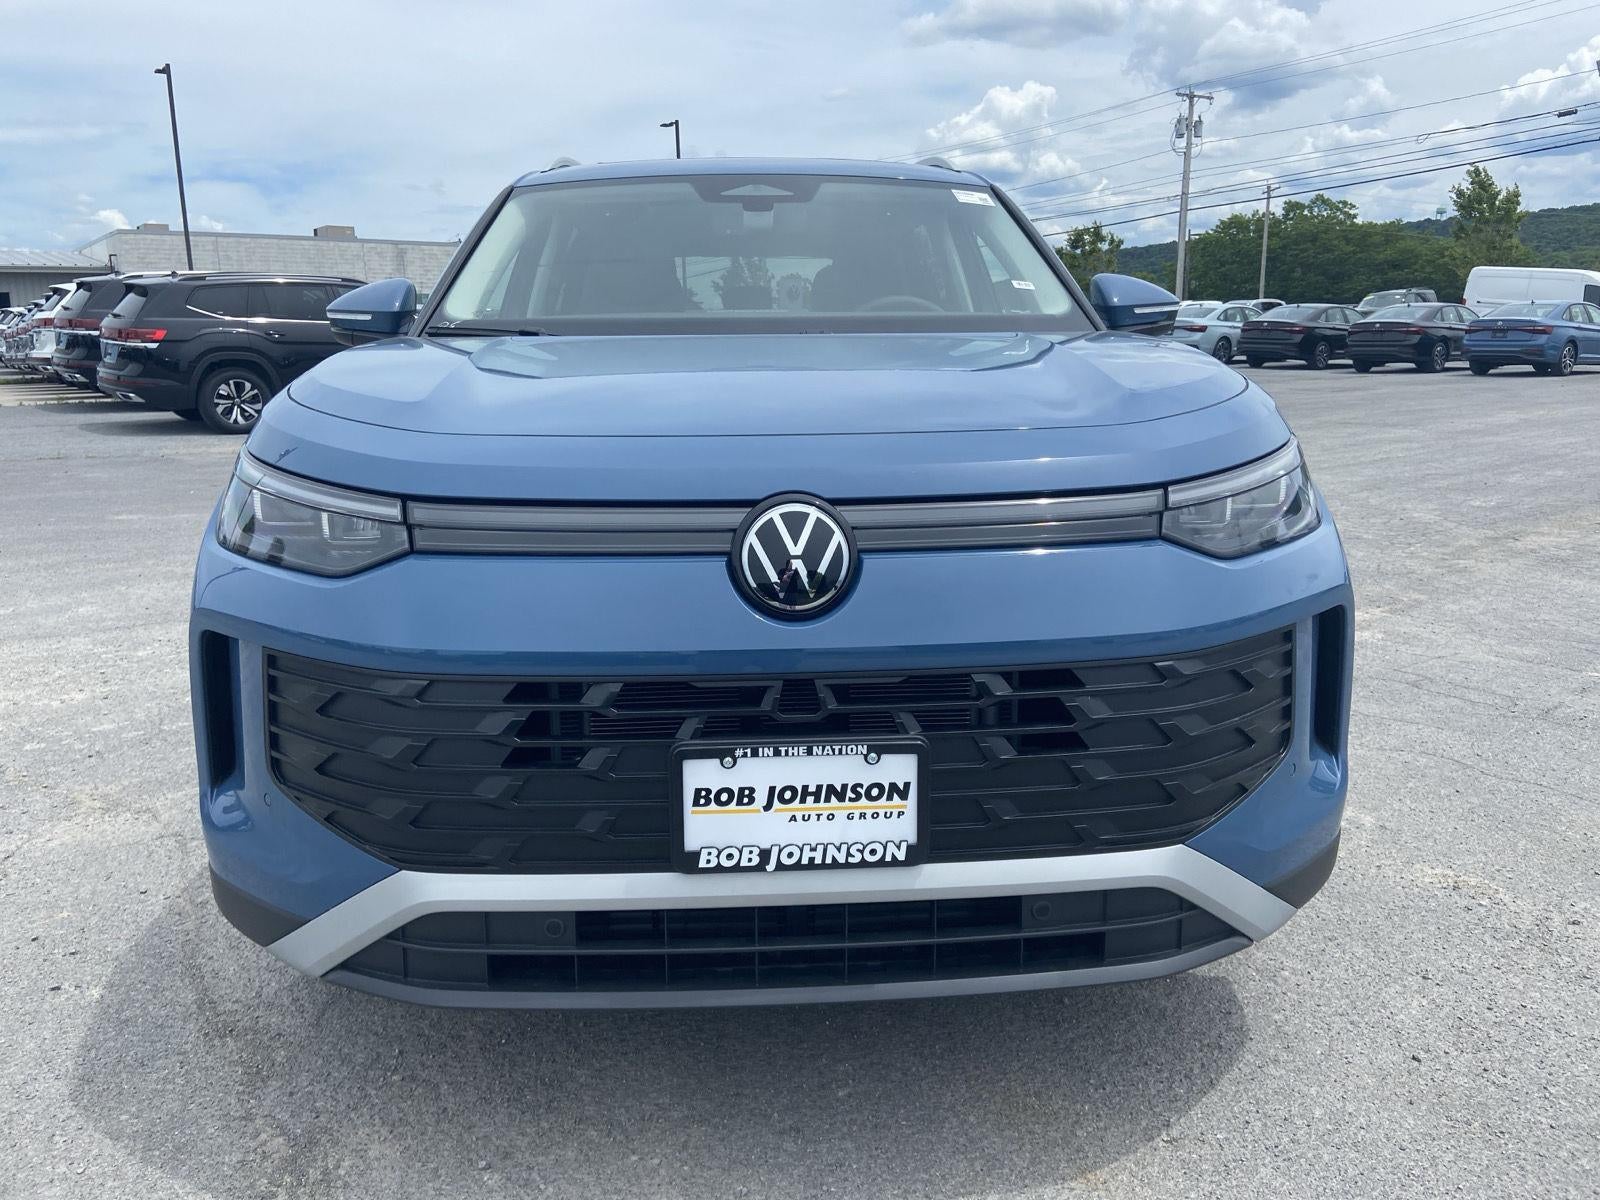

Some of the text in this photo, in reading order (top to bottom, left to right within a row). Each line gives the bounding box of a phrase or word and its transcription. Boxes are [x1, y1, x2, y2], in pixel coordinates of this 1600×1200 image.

[734, 744, 868, 758] #1 IN THE NATION
[692, 781, 912, 812] BOB JOHNSON
[788, 810, 906, 823] AUTO GROUP
[698, 841, 909, 872] BOB JOHNSON
